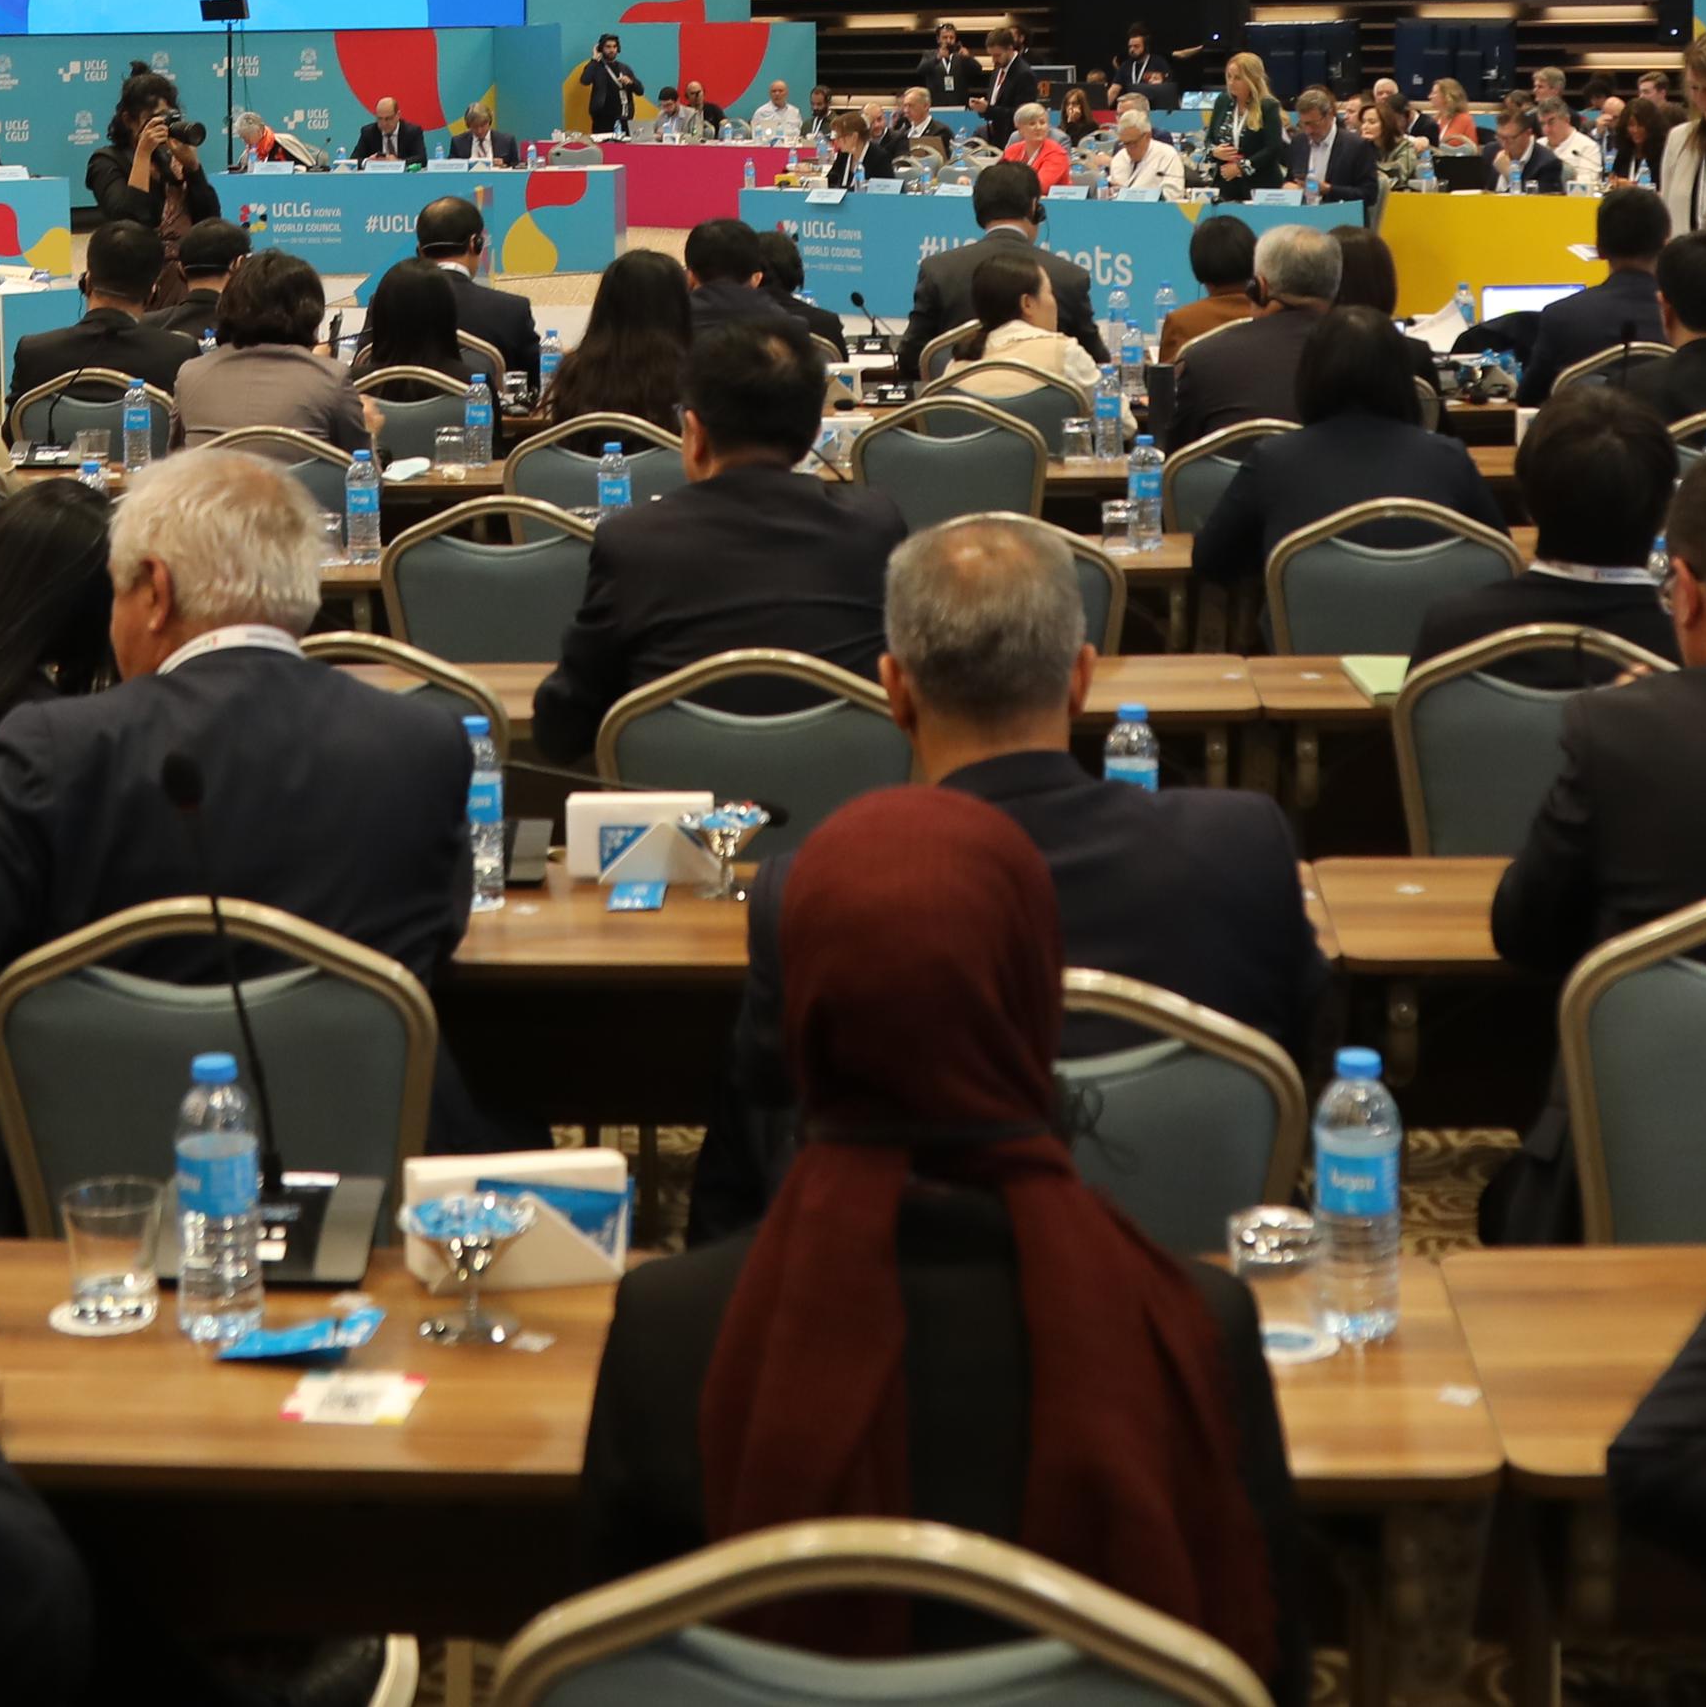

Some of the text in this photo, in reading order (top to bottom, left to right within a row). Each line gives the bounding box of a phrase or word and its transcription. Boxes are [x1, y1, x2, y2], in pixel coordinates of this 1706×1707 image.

[84, 59, 108, 71] UCLG
[84, 71, 108, 82] CGLU
[272, 202, 341, 218] UCLG KONYA
[273, 223, 341, 233] WORLD COUNCIL
[803, 221, 836, 239] UCLG
